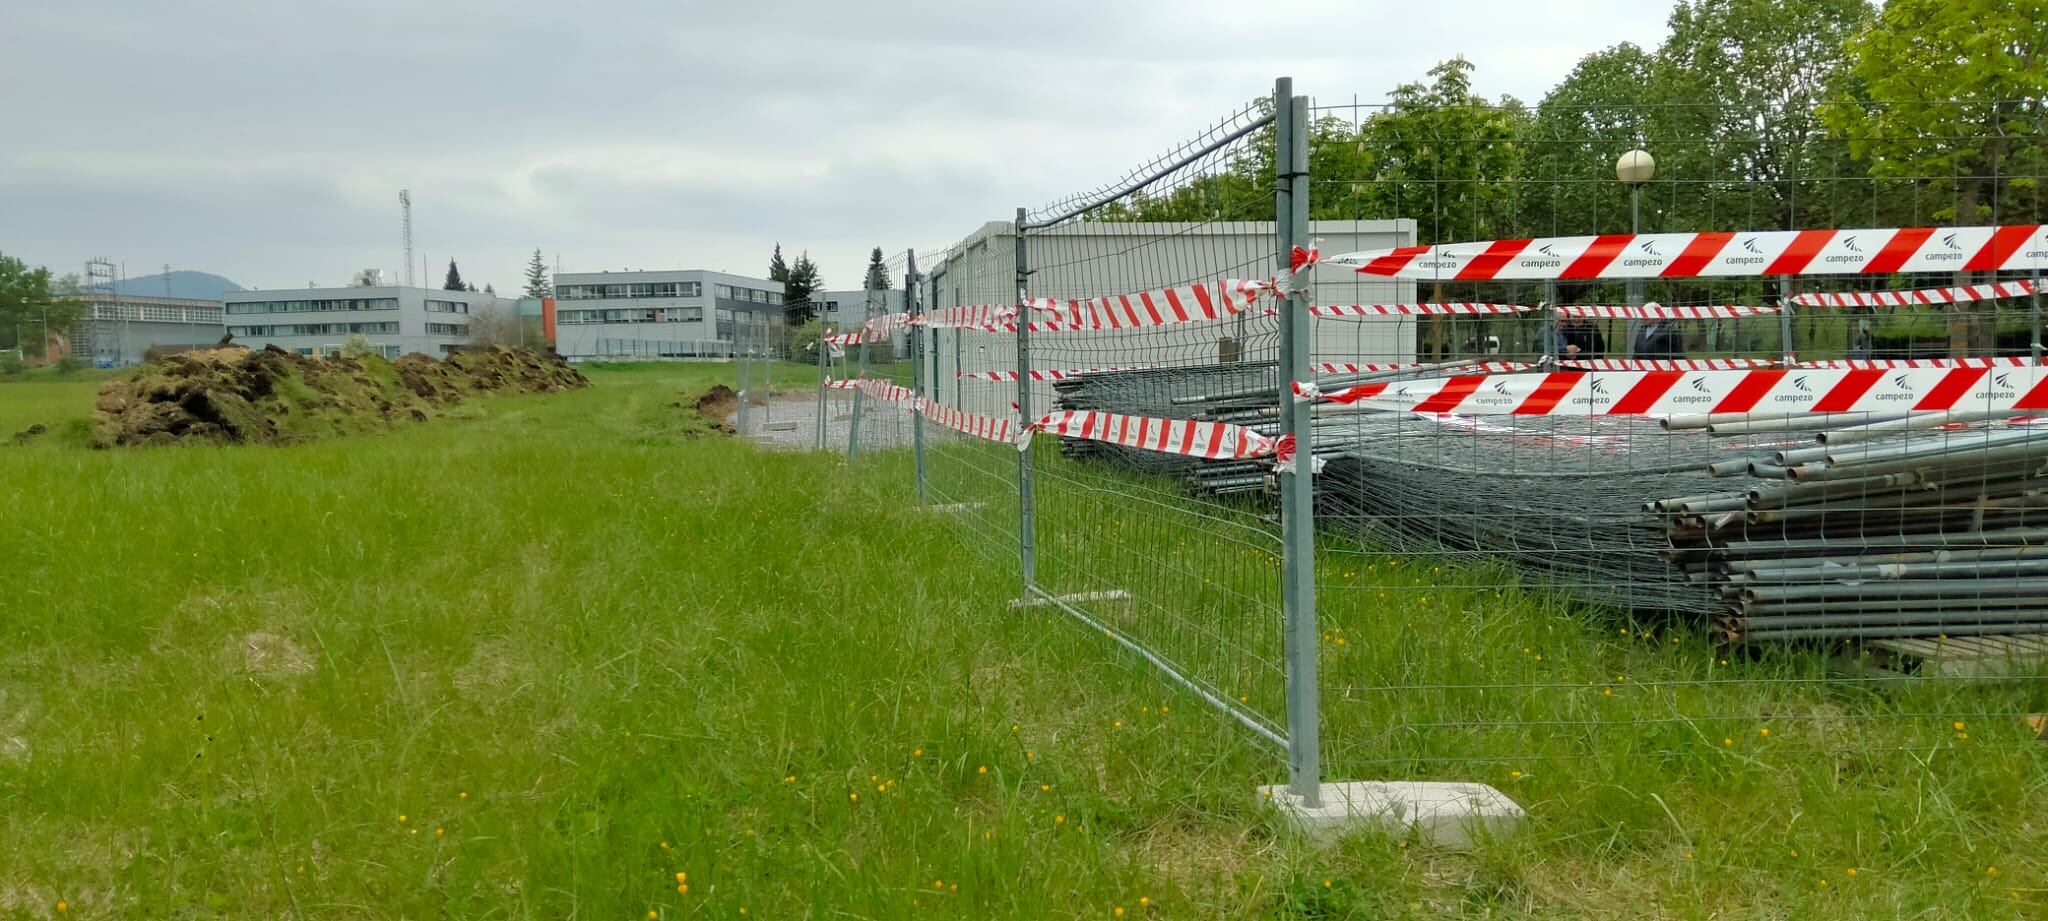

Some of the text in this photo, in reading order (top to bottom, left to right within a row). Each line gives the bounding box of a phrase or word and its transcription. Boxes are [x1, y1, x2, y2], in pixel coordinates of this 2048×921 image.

[1419, 261, 1457, 269] campezo
[1521, 260, 1561, 269] campezo
[1623, 258, 1662, 268] campezo
[1726, 257, 1764, 266] campezo
[1826, 255, 1864, 264] campezo
[1925, 252, 1963, 262] campezo
[1572, 396, 1610, 405] campezo
[1673, 395, 1712, 404] campezo
[1775, 393, 1813, 402] campezo
[1875, 392, 1914, 401] campezo
[1975, 391, 2015, 400] campezo
